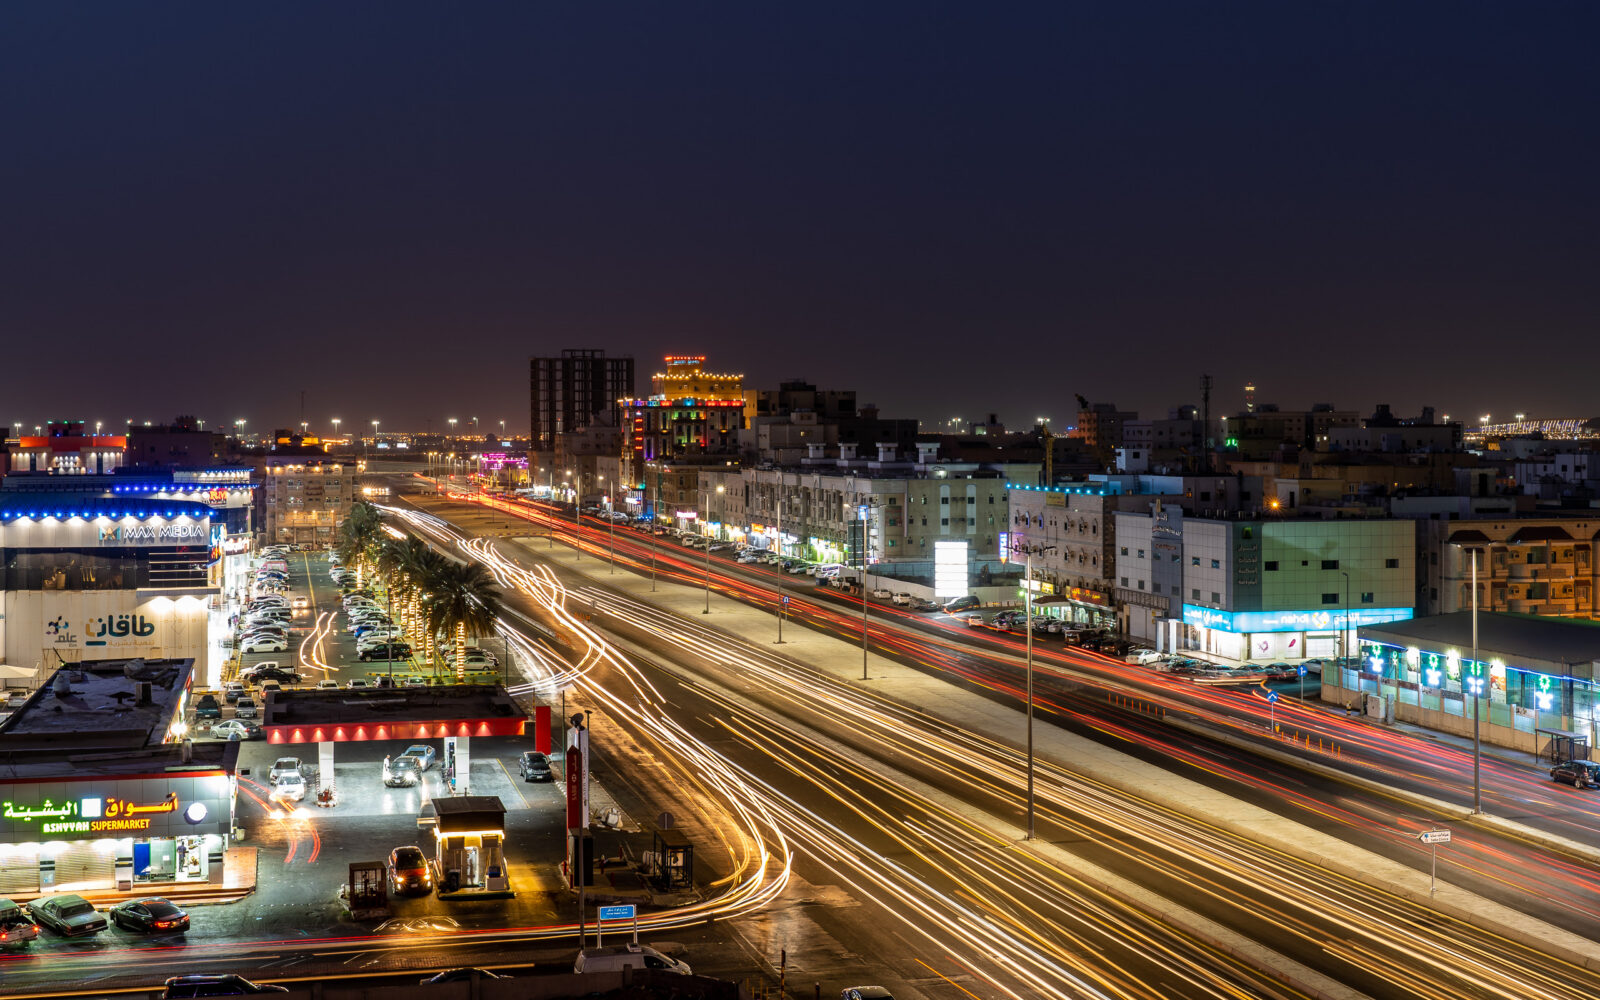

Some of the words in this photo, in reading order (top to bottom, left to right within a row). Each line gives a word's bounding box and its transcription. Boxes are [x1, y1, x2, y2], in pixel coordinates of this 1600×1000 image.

[124, 526, 155, 539] MAX
[159, 525, 204, 538] MEDIA
[105, 791, 179, 818] أسواق
[90, 818, 151, 831] SUPERMARKET
